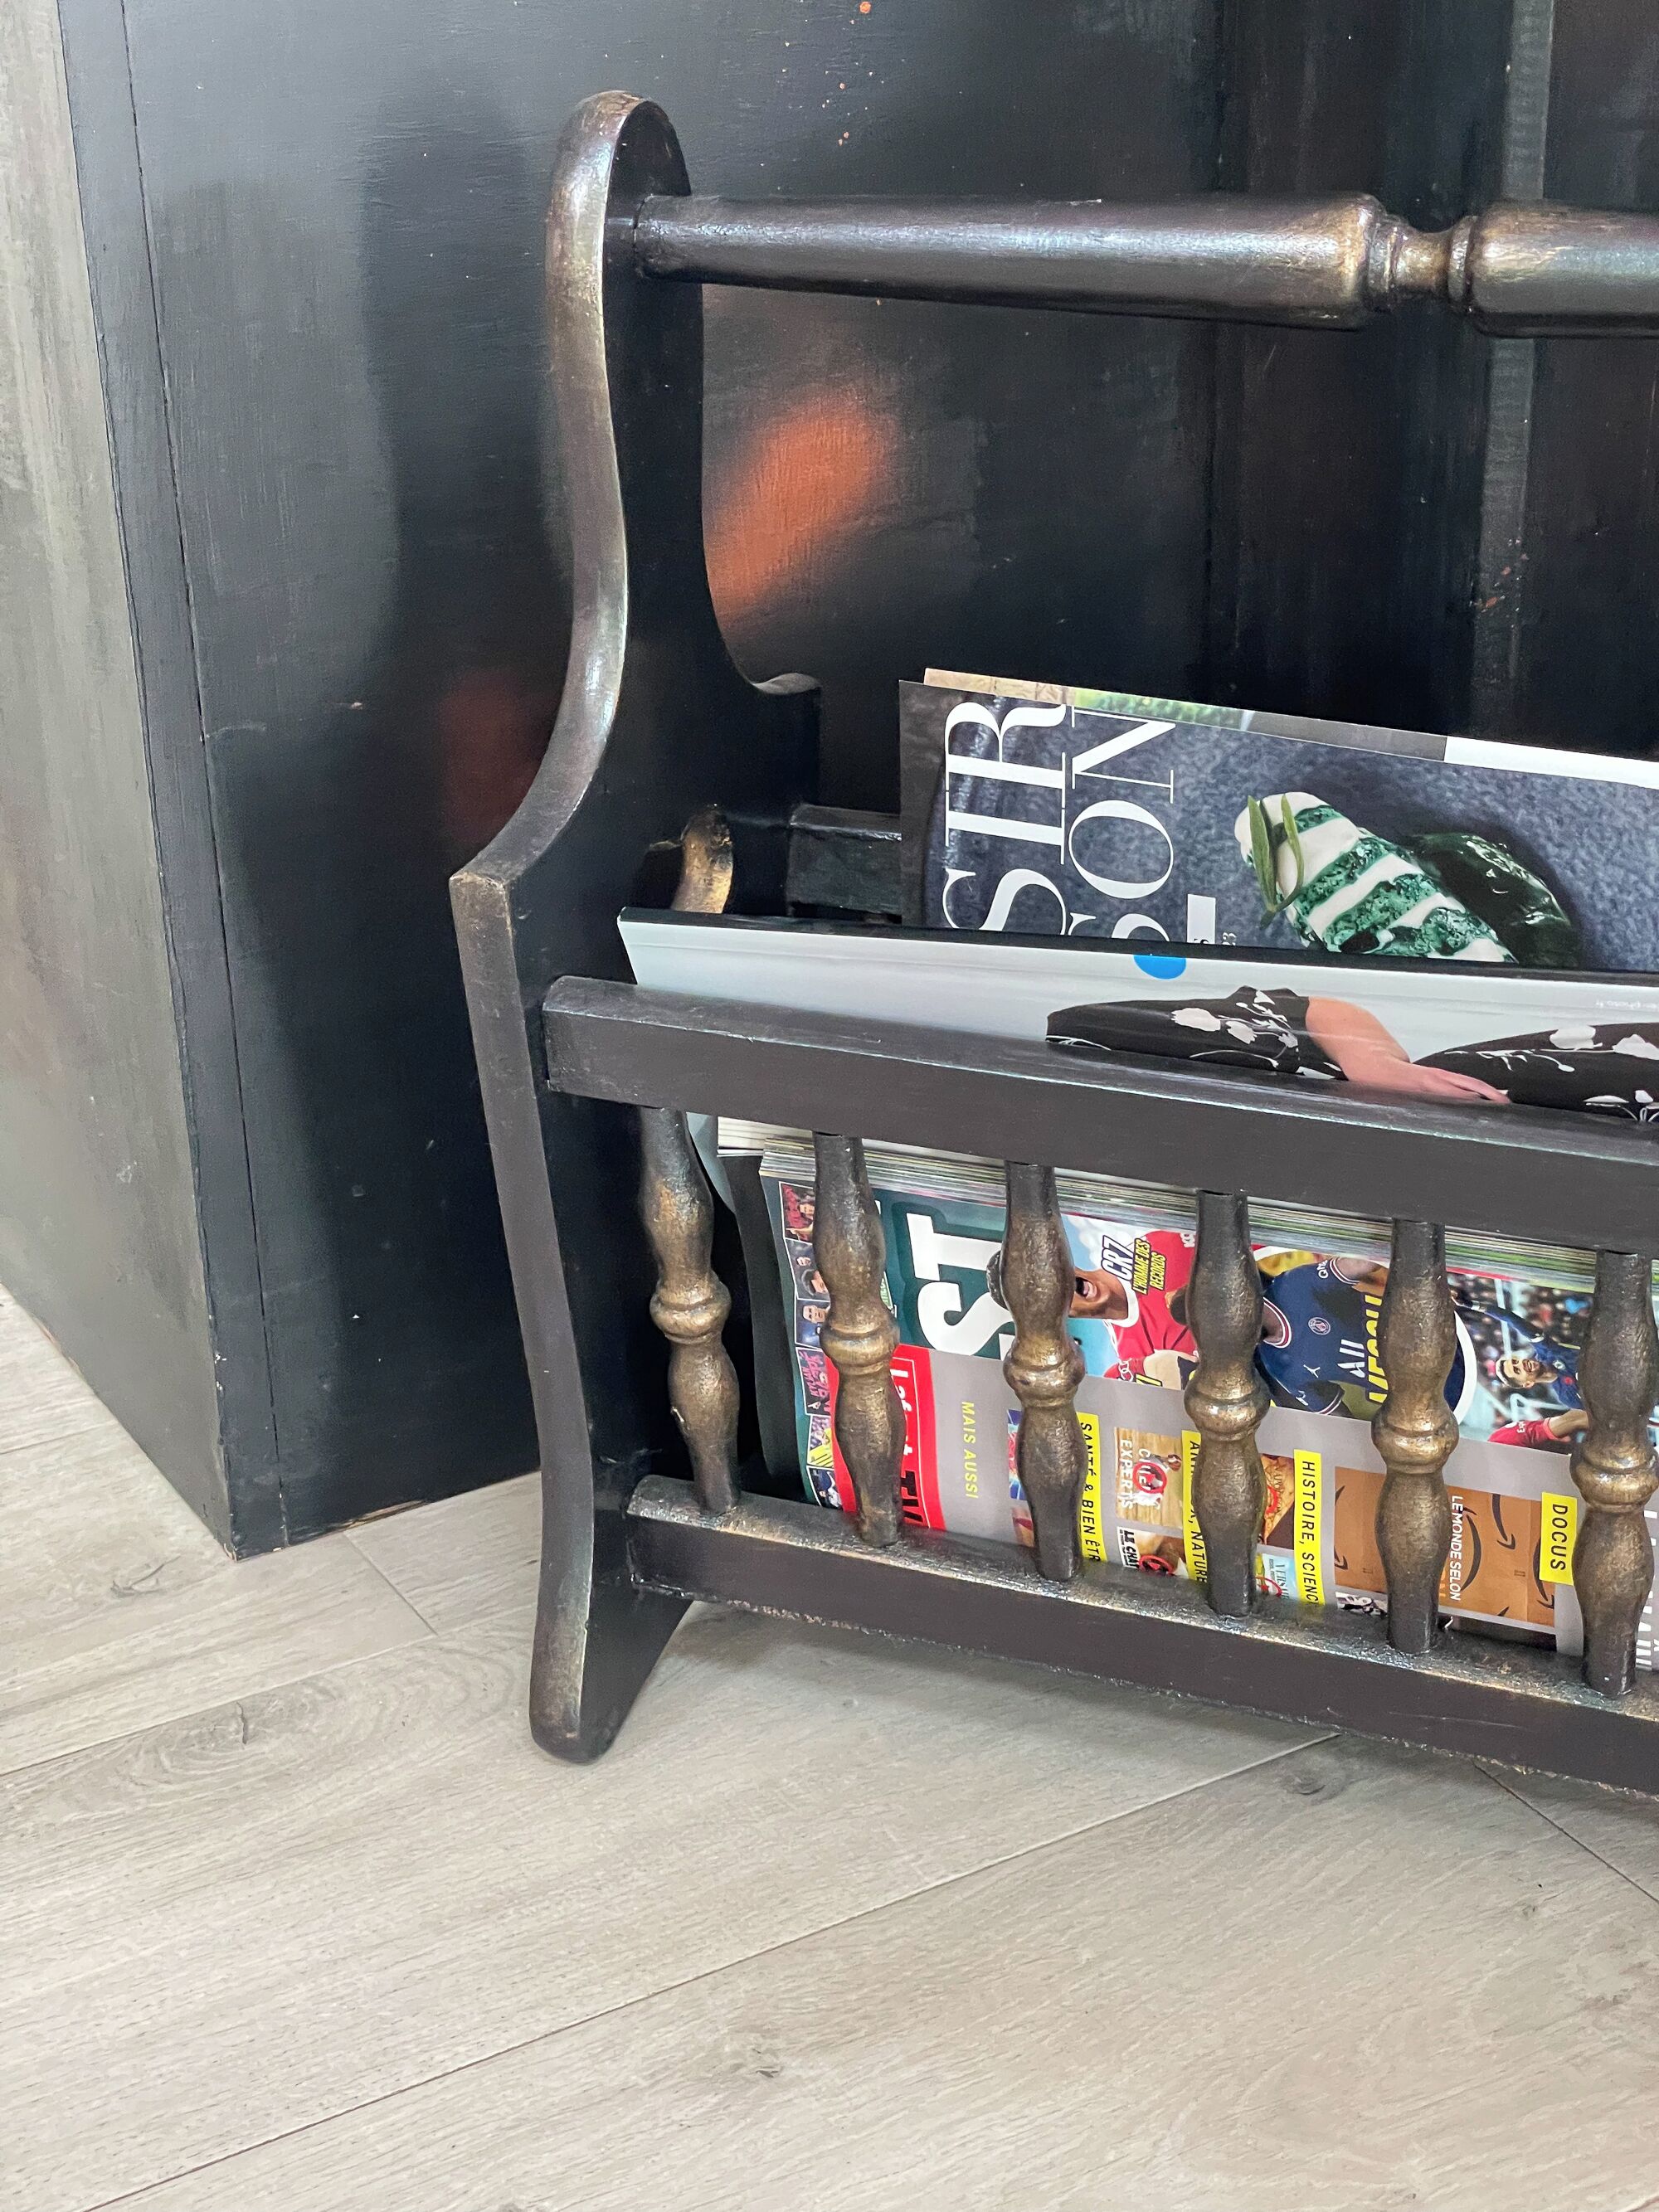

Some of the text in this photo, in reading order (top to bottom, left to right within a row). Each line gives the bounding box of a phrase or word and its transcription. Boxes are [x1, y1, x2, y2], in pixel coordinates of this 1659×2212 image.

[1102, 1235, 1133, 1281] CR7
[1132, 1238, 1151, 1296] L'HOMME DES
[1150, 1251, 1167, 1291] RECORDS
[961, 1401, 979, 1499] MAIS AUSSI
[1120, 1439, 1133, 1510] EXPERTS
[1081, 1499, 1096, 1534] BIEN
[1084, 1483, 1094, 1492] &
[1124, 1529, 1136, 1544] LE
[1300, 1460, 1320, 1606] HISTOIRE, SCIENC
[1449, 1495, 1463, 1601] LE MONDE SELON
[1550, 1504, 1568, 1572] DOCUS
